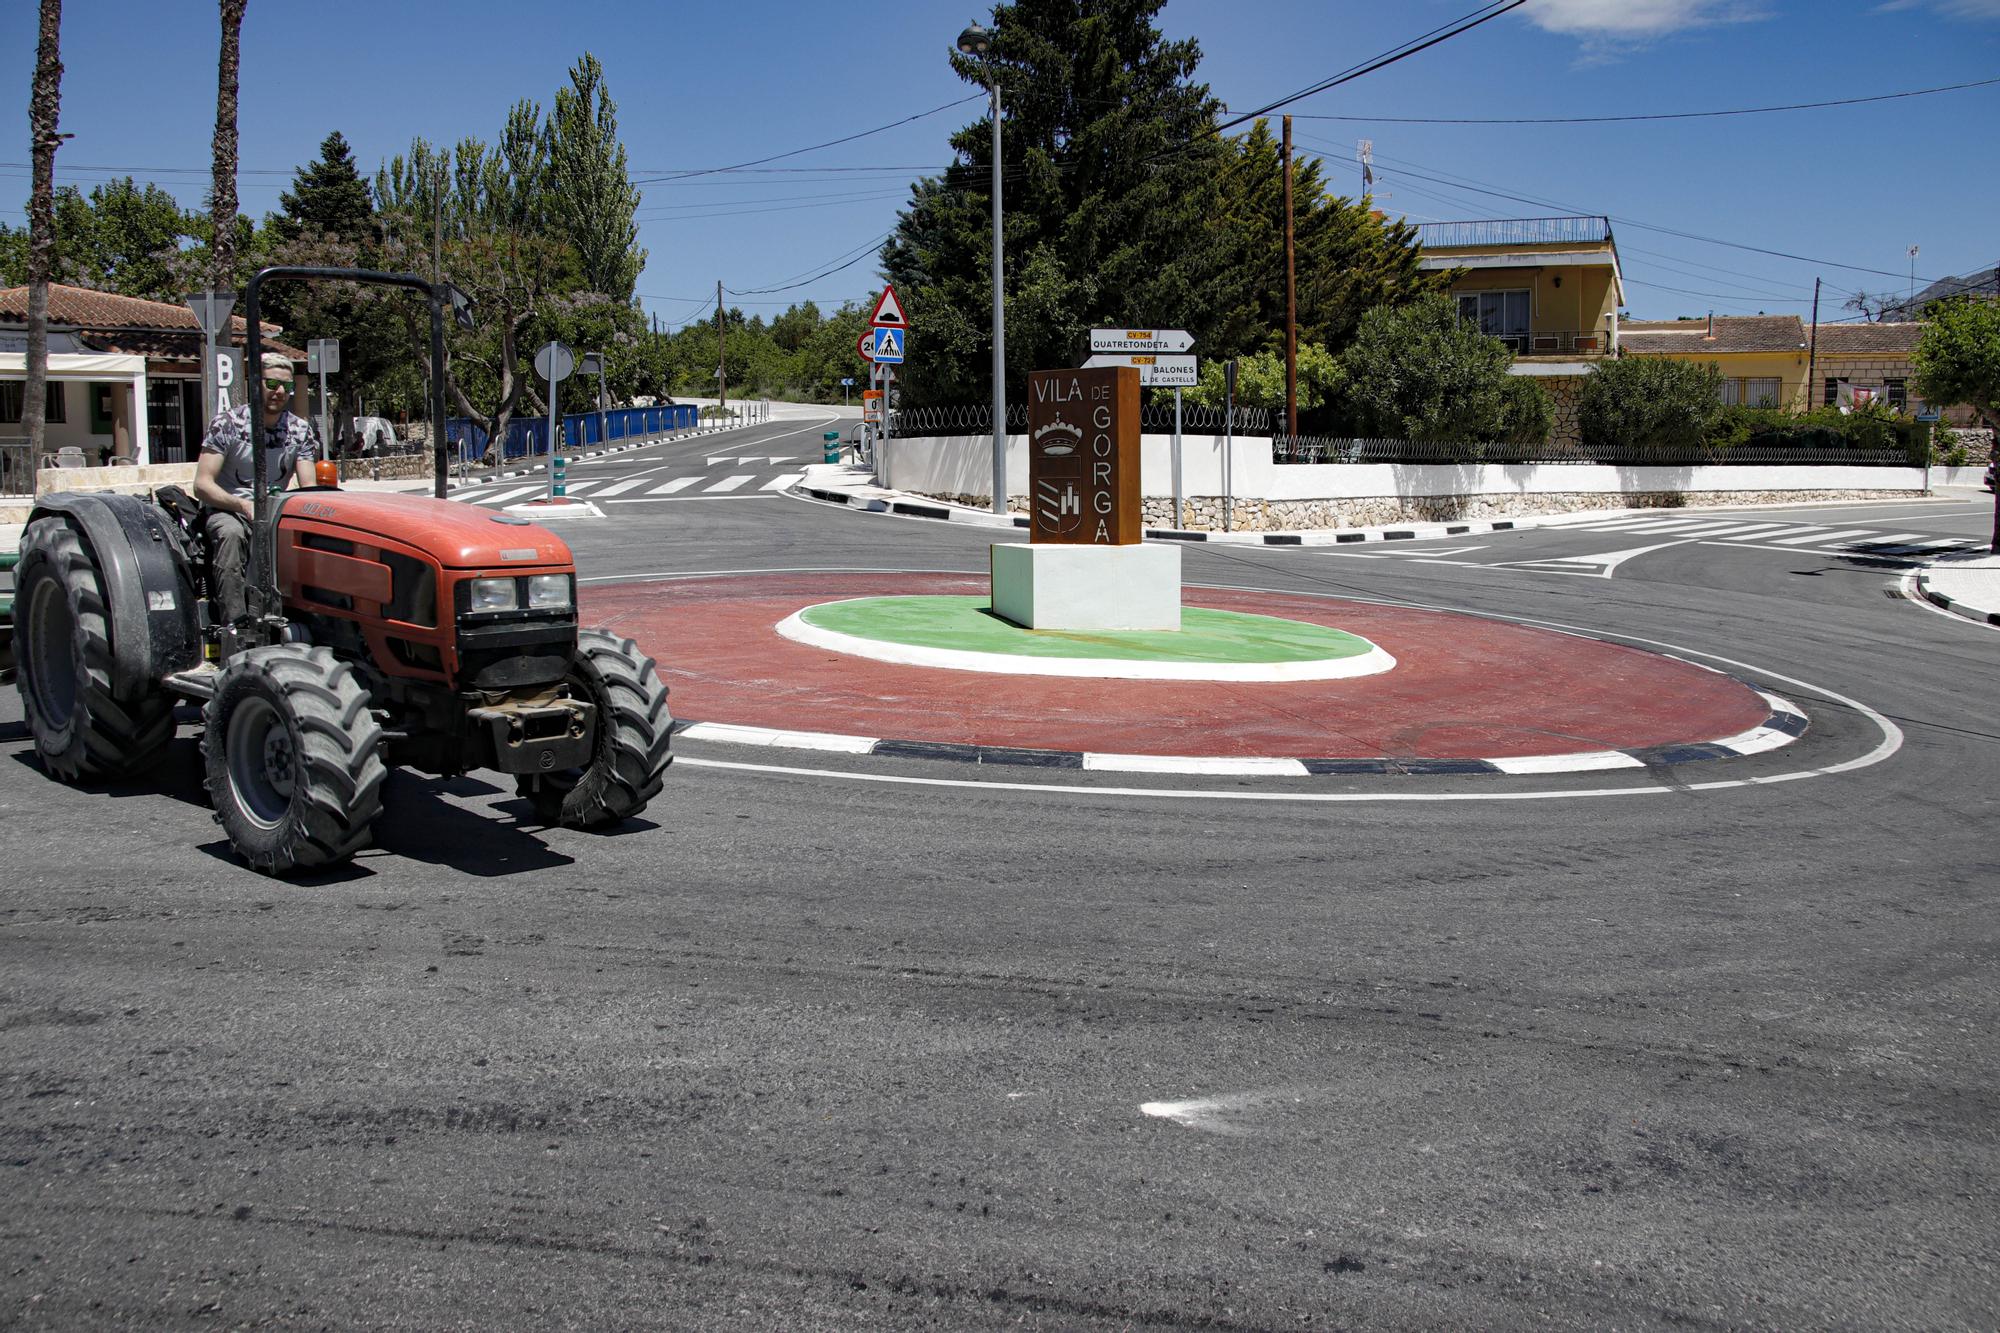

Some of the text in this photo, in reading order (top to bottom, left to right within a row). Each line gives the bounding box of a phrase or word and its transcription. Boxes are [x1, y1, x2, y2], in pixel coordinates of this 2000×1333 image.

[1093, 340, 1185, 349] QUATRETONDETA 4
[1153, 366, 1194, 374] BALONES
[1034, 377, 1111, 403] VILA DE
[1093, 405, 1112, 543] GORGA
